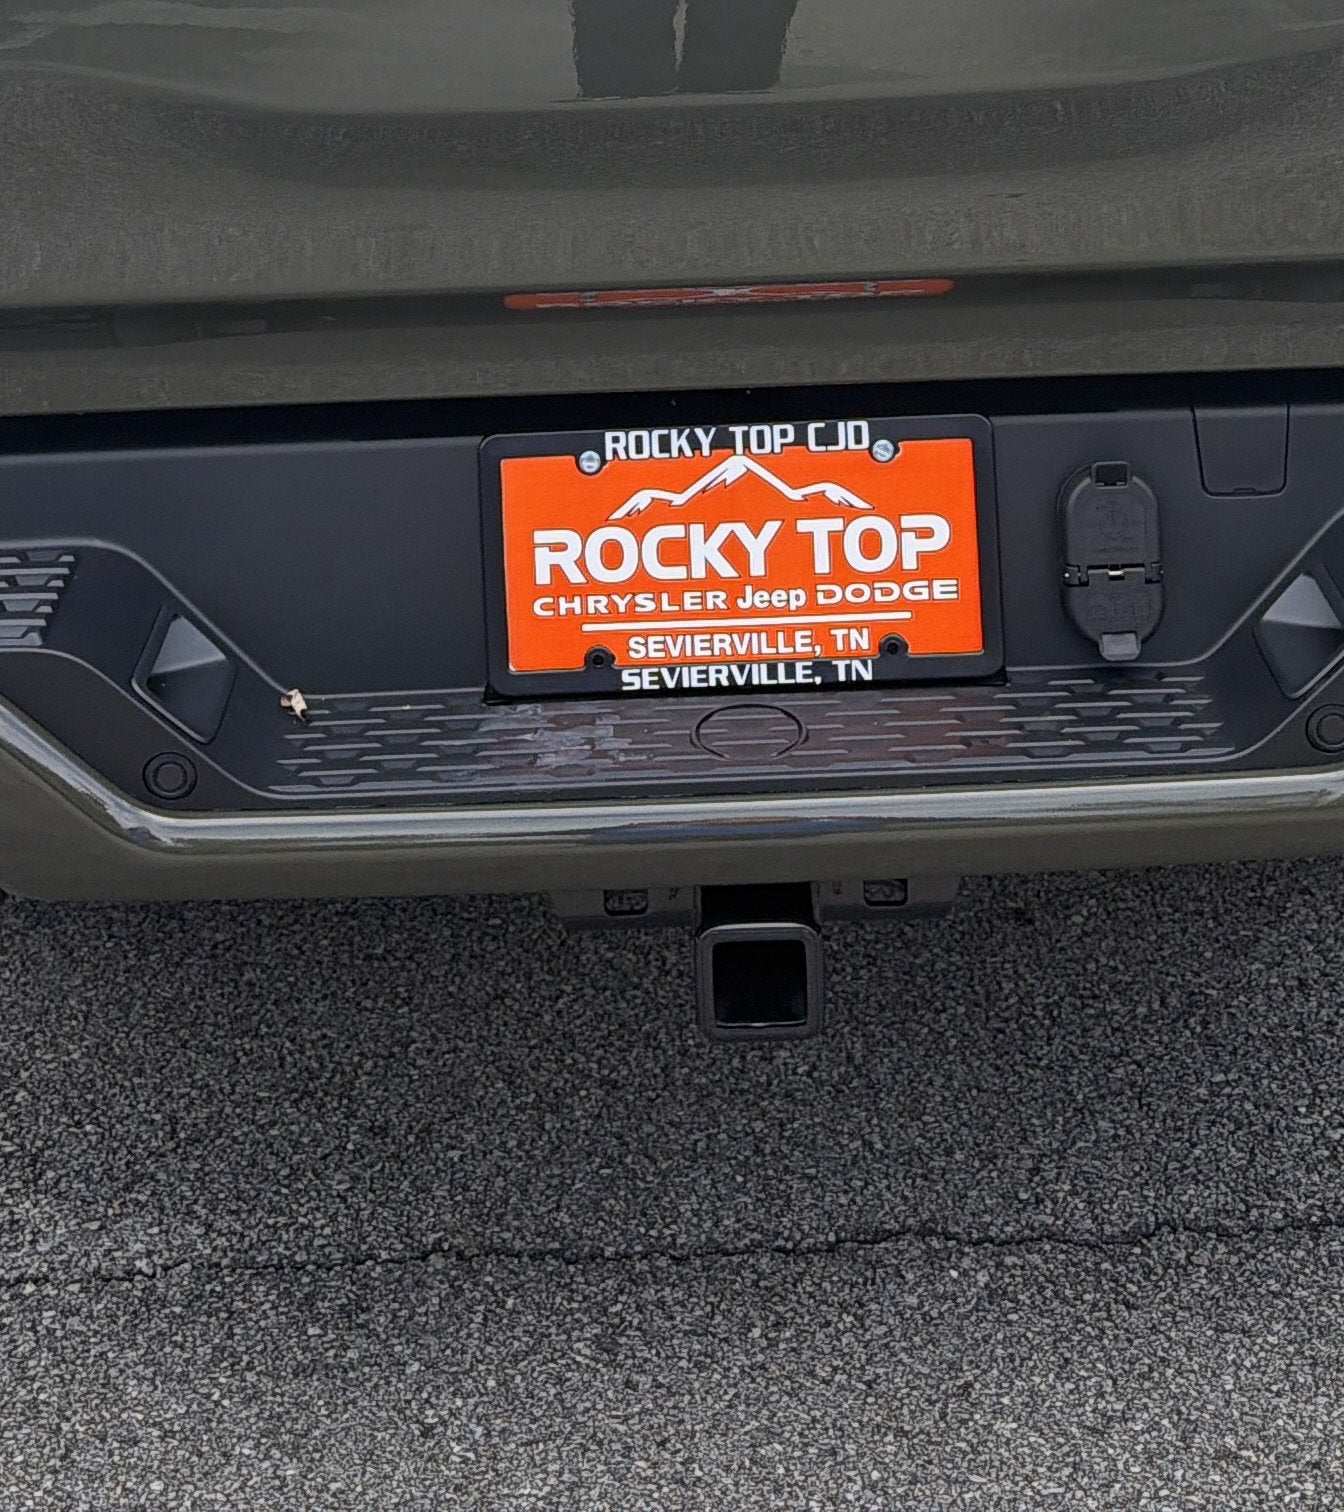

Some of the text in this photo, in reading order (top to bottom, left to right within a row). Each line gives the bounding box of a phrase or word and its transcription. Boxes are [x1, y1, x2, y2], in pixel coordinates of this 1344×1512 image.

[604, 419, 870, 461] ROCKY TOP CJD
[532, 514, 952, 586] ROCKY TOP
[532, 579, 959, 617] CHRYSLER Jeep DODGE
[627, 627, 871, 659] SEVIERVILLE, TN
[621, 658, 874, 691] SEVIERVILLE, TN
